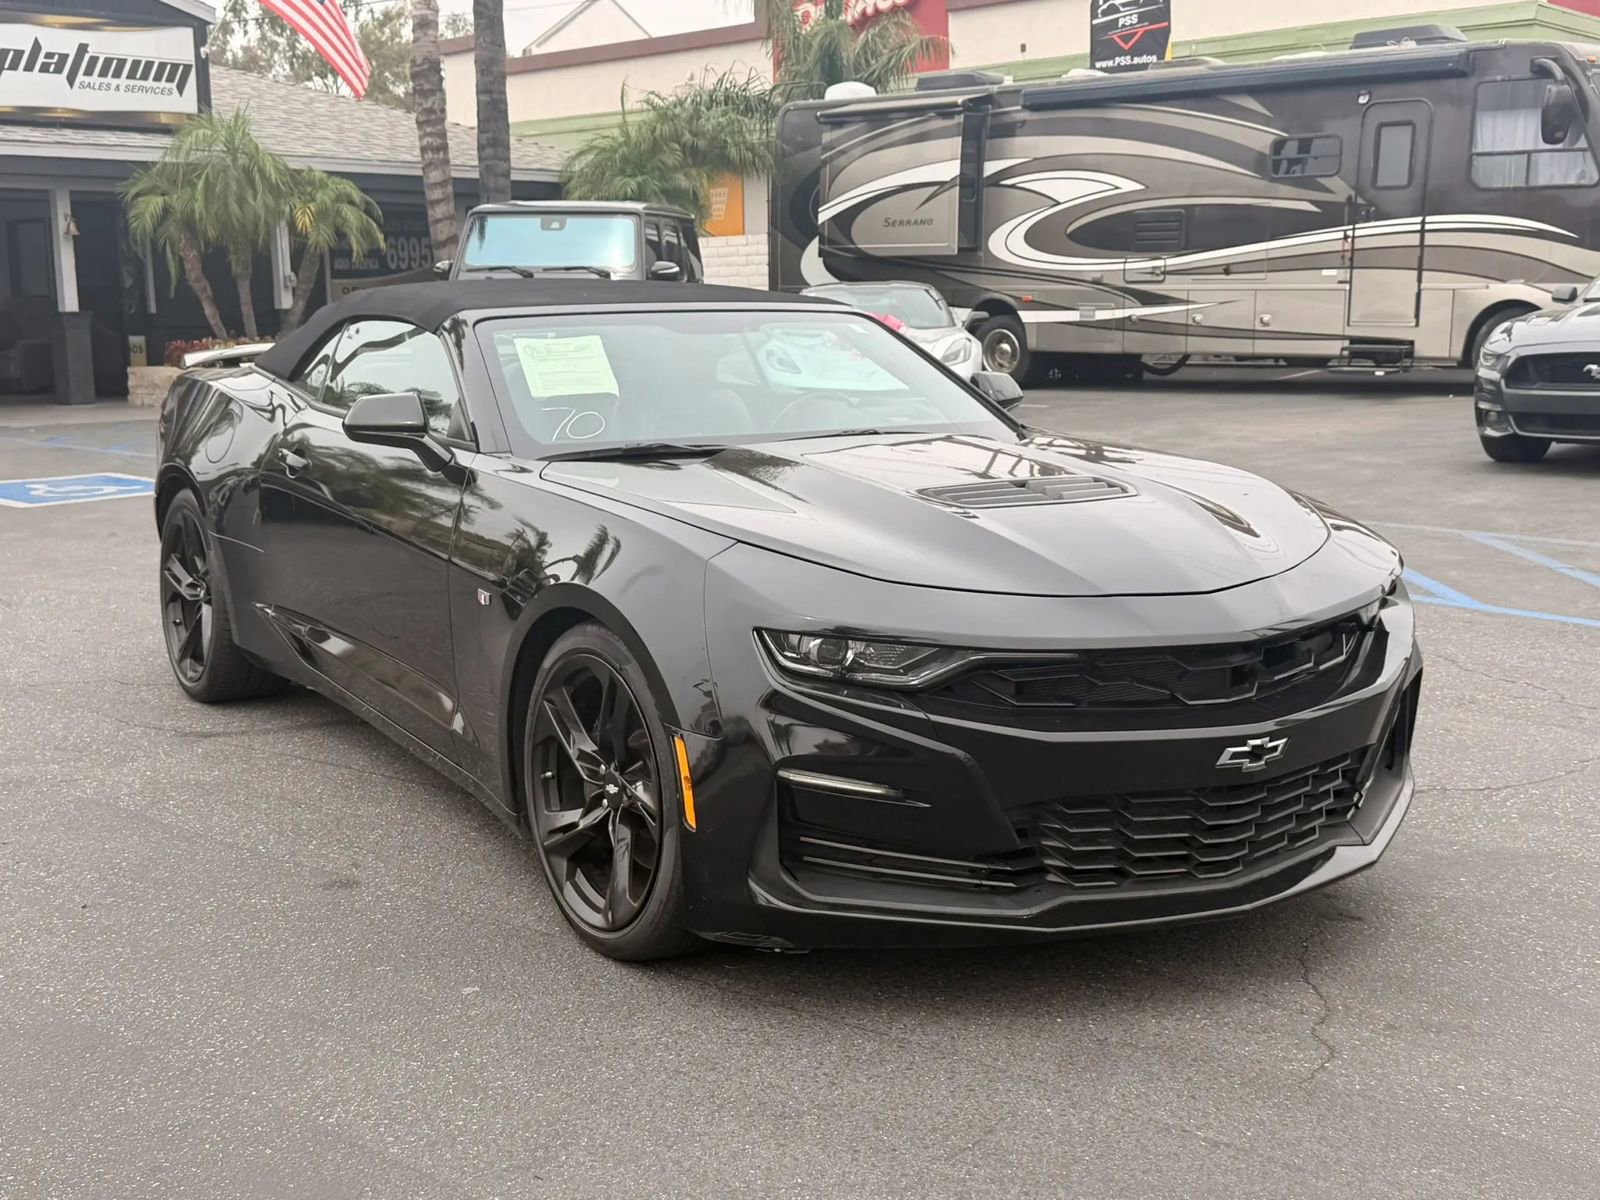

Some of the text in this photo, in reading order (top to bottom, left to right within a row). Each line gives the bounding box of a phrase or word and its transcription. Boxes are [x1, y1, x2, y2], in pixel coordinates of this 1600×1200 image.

[1118, 14, 1138, 27] PSS
[0, 36, 193, 97] platinum
[1094, 55, 1157, 68] www.PSS.autos
[78, 81, 174, 96] SALES & SERVICES
[882, 217, 934, 228] SERRANO
[387, 237, 432, 270] 6995
[541, 407, 605, 441] 70
